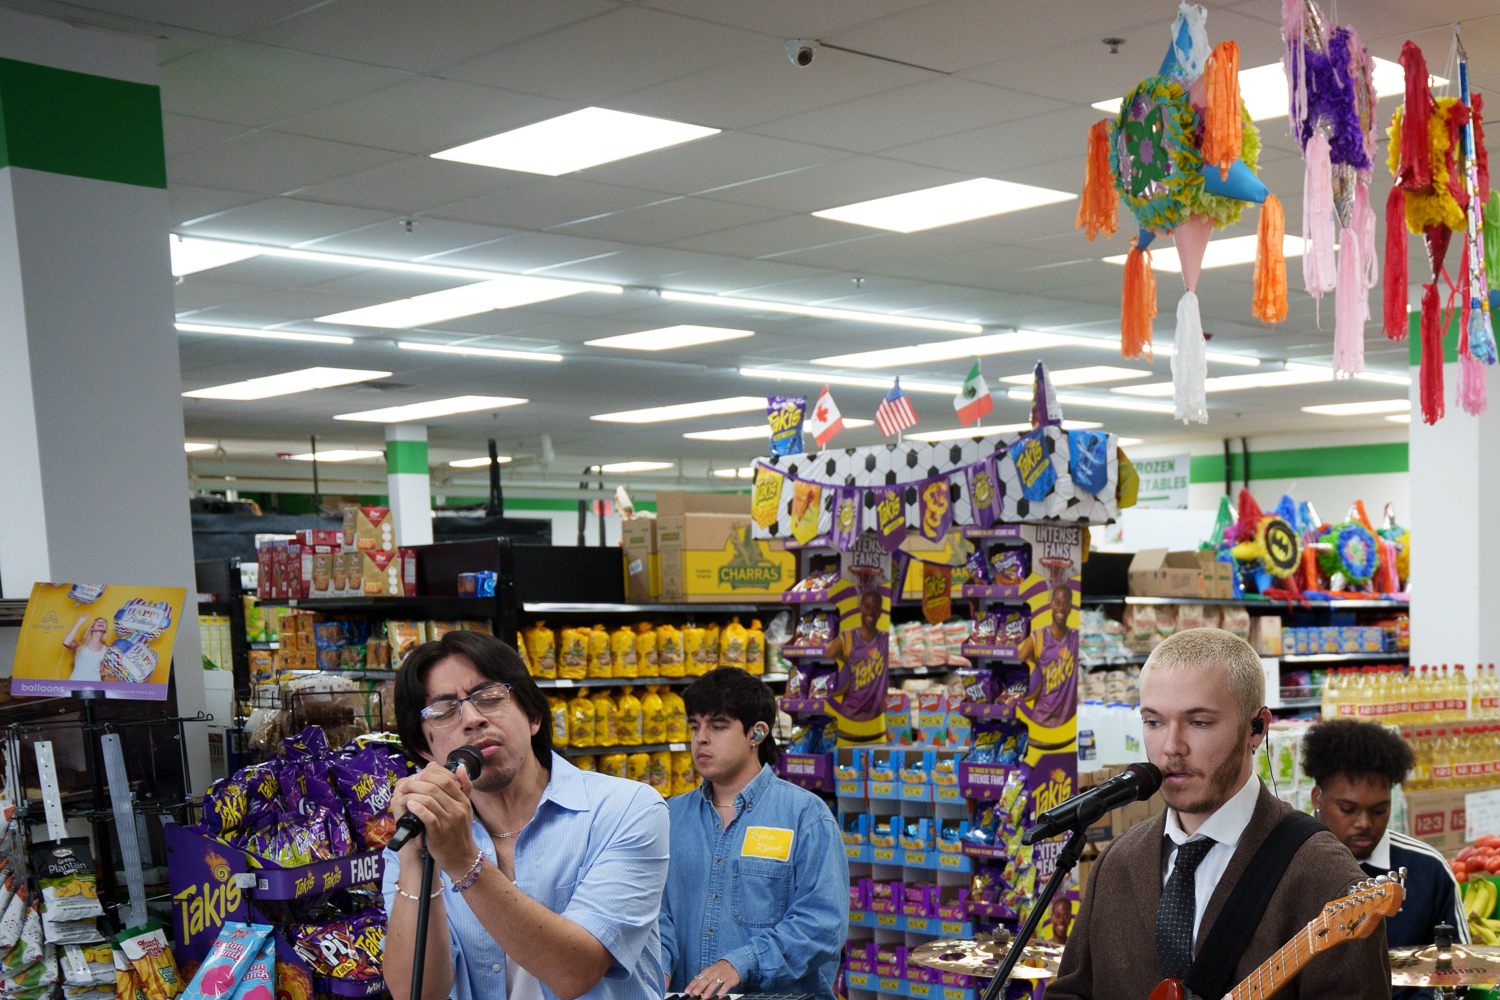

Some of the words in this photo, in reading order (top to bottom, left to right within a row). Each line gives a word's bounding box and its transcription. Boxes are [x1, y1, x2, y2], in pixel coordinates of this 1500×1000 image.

[767, 407, 802, 434] Takis
[1016, 438, 1044, 485] Takis
[1134, 461, 1175, 474] ROZEN
[755, 477, 779, 506] Takis
[877, 494, 901, 531] Takis
[1036, 525, 1080, 545] INTENSE
[853, 551, 881, 567] FANS
[1044, 542, 1071, 558] FANS
[721, 567, 779, 581] CHARRAS
[924, 573, 947, 600] Takis
[121, 614, 158, 630] Birthday
[127, 607, 162, 620] HAPPY
[133, 644, 154, 667] HAPP
[851, 654, 885, 692] Takis
[1042, 654, 1075, 695] Takis
[21, 683, 65, 694] balloons
[968, 773, 990, 784] INTENSE
[990, 774, 1005, 785] FANS
[1419, 814, 1443, 832] 123
[48, 862, 87, 874] Plantain
[57, 857, 75, 865] Green
[350, 854, 381, 884] FACE
[295, 873, 315, 899] Takis
[322, 867, 342, 893] Takis
[173, 873, 242, 946] Takis
[243, 970, 270, 981] andy
